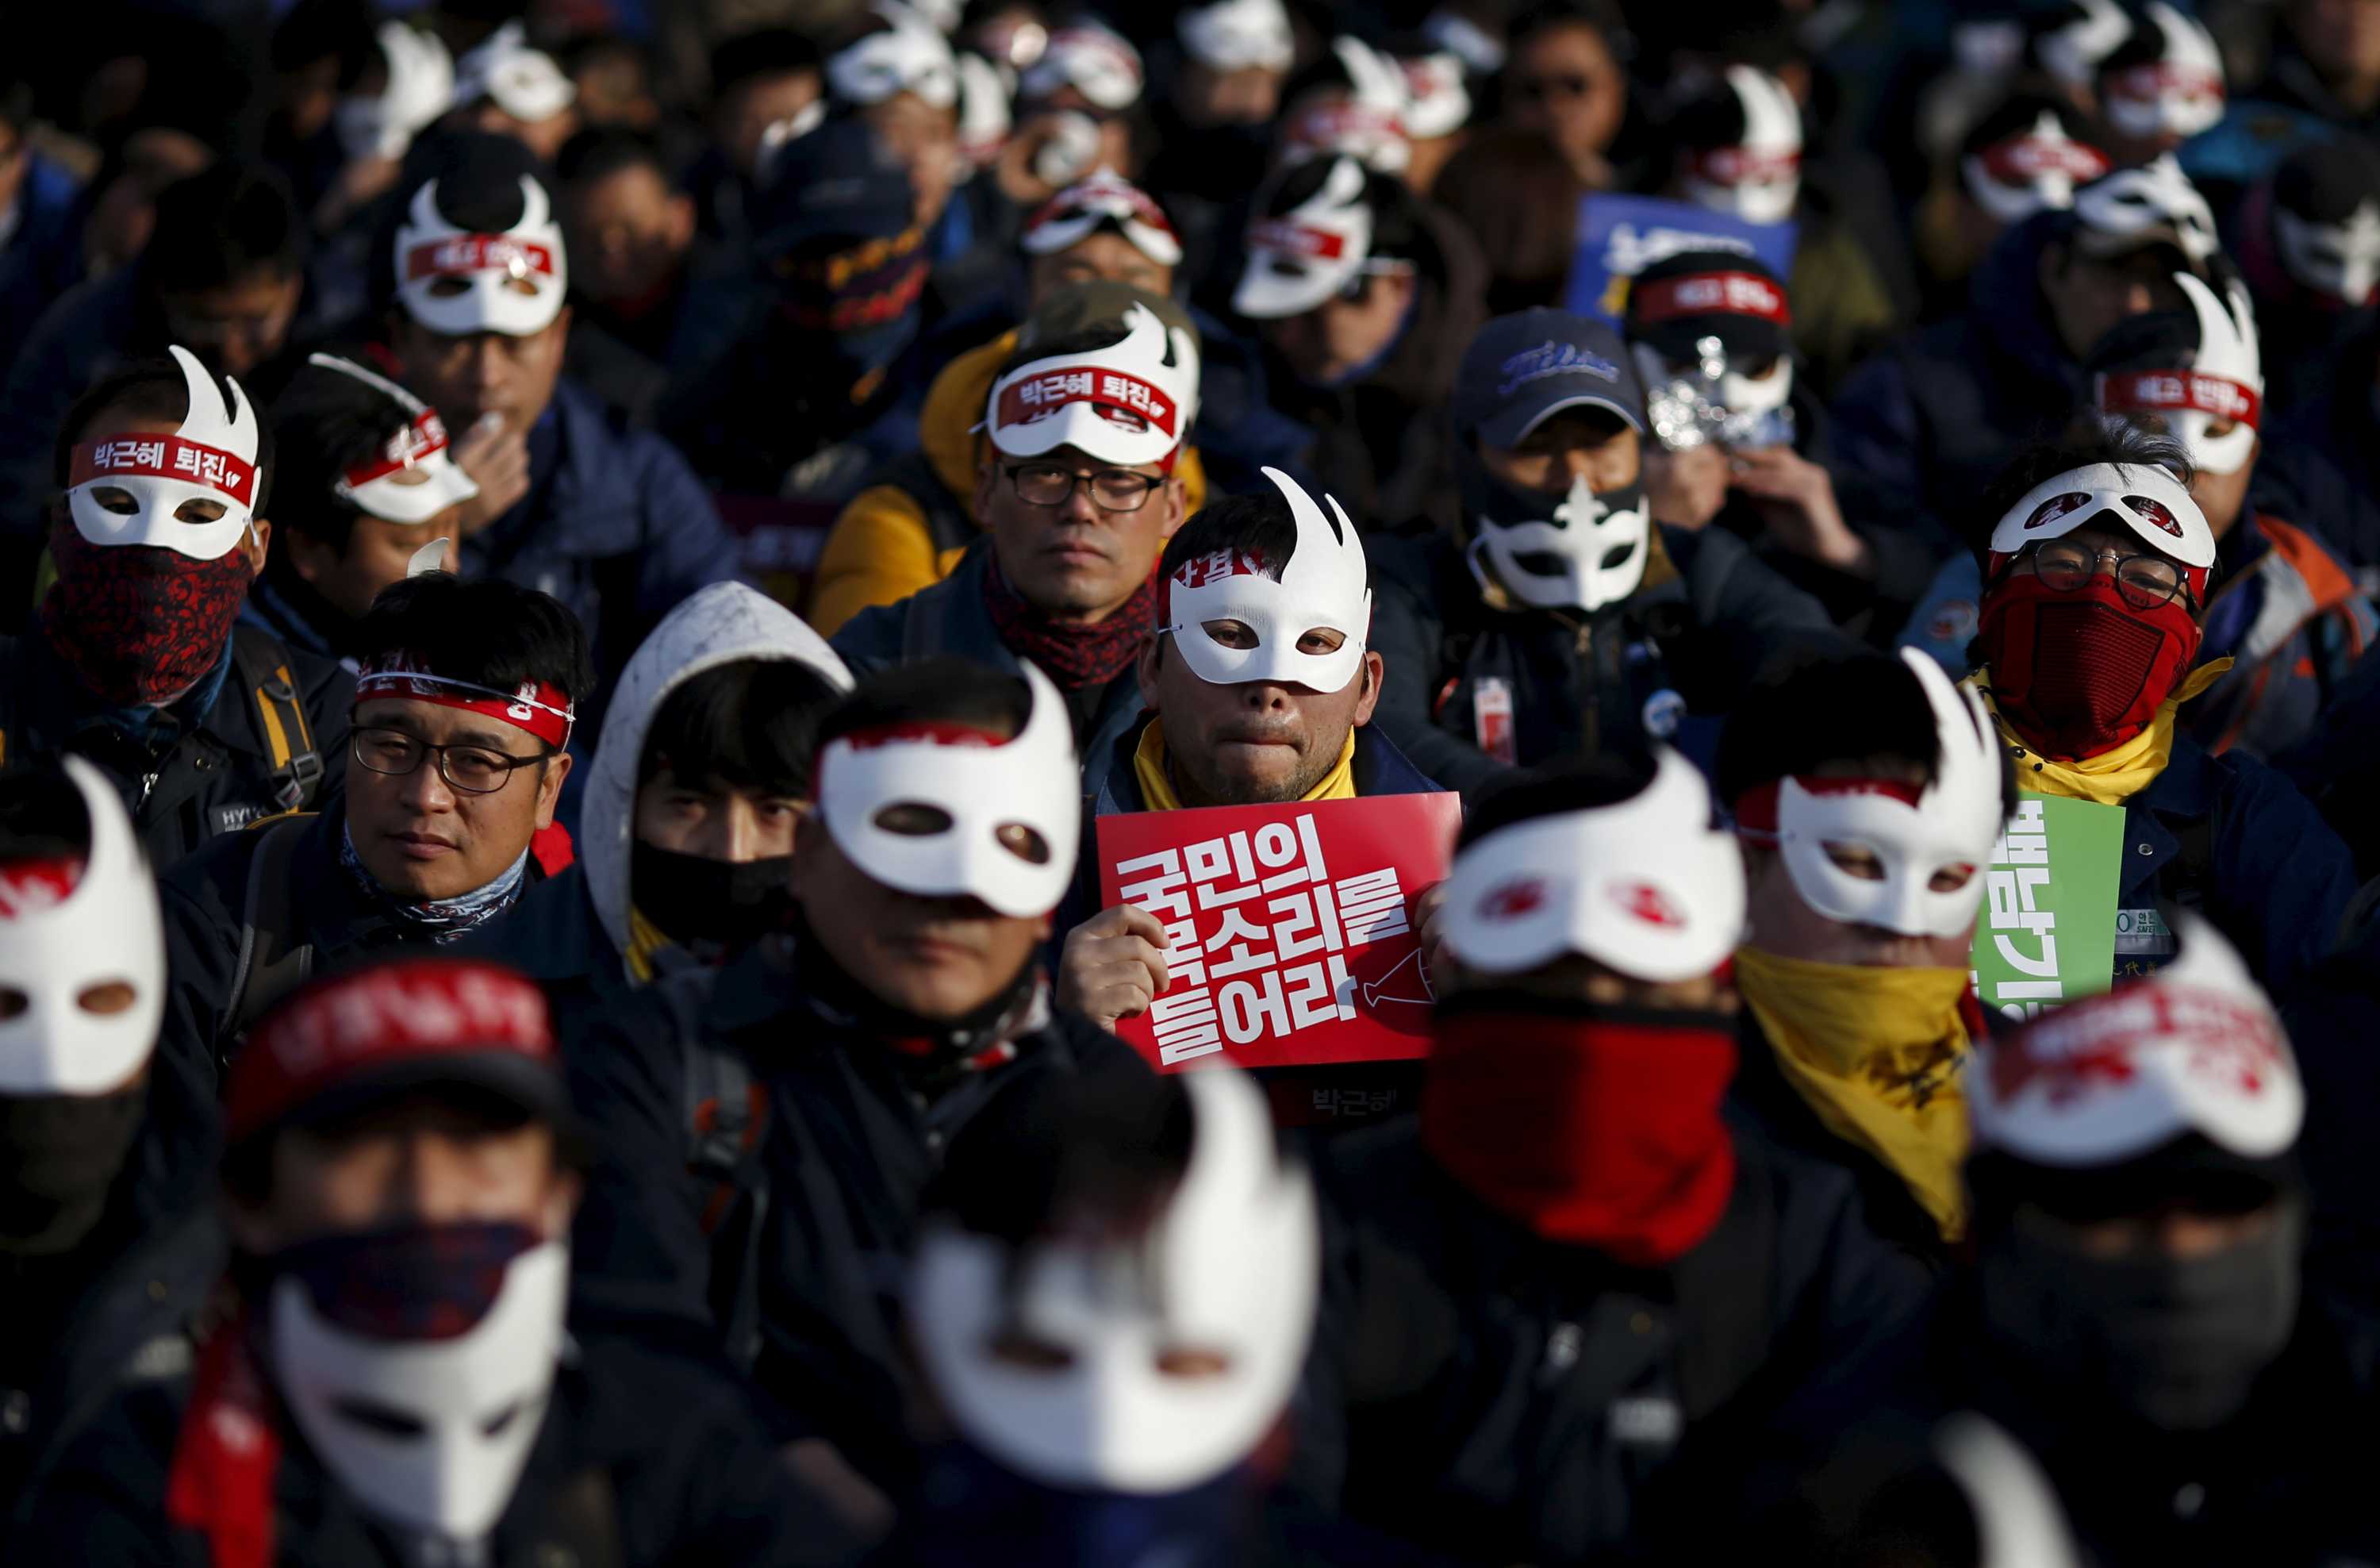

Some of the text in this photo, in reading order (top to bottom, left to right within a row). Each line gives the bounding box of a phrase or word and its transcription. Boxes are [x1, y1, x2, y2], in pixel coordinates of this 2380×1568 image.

[1020, 372, 1093, 404] 박근혜
[94, 441, 165, 469] 박근혜
[1117, 813, 1327, 918] 국민의
[1150, 954, 1357, 1066] 들어라
